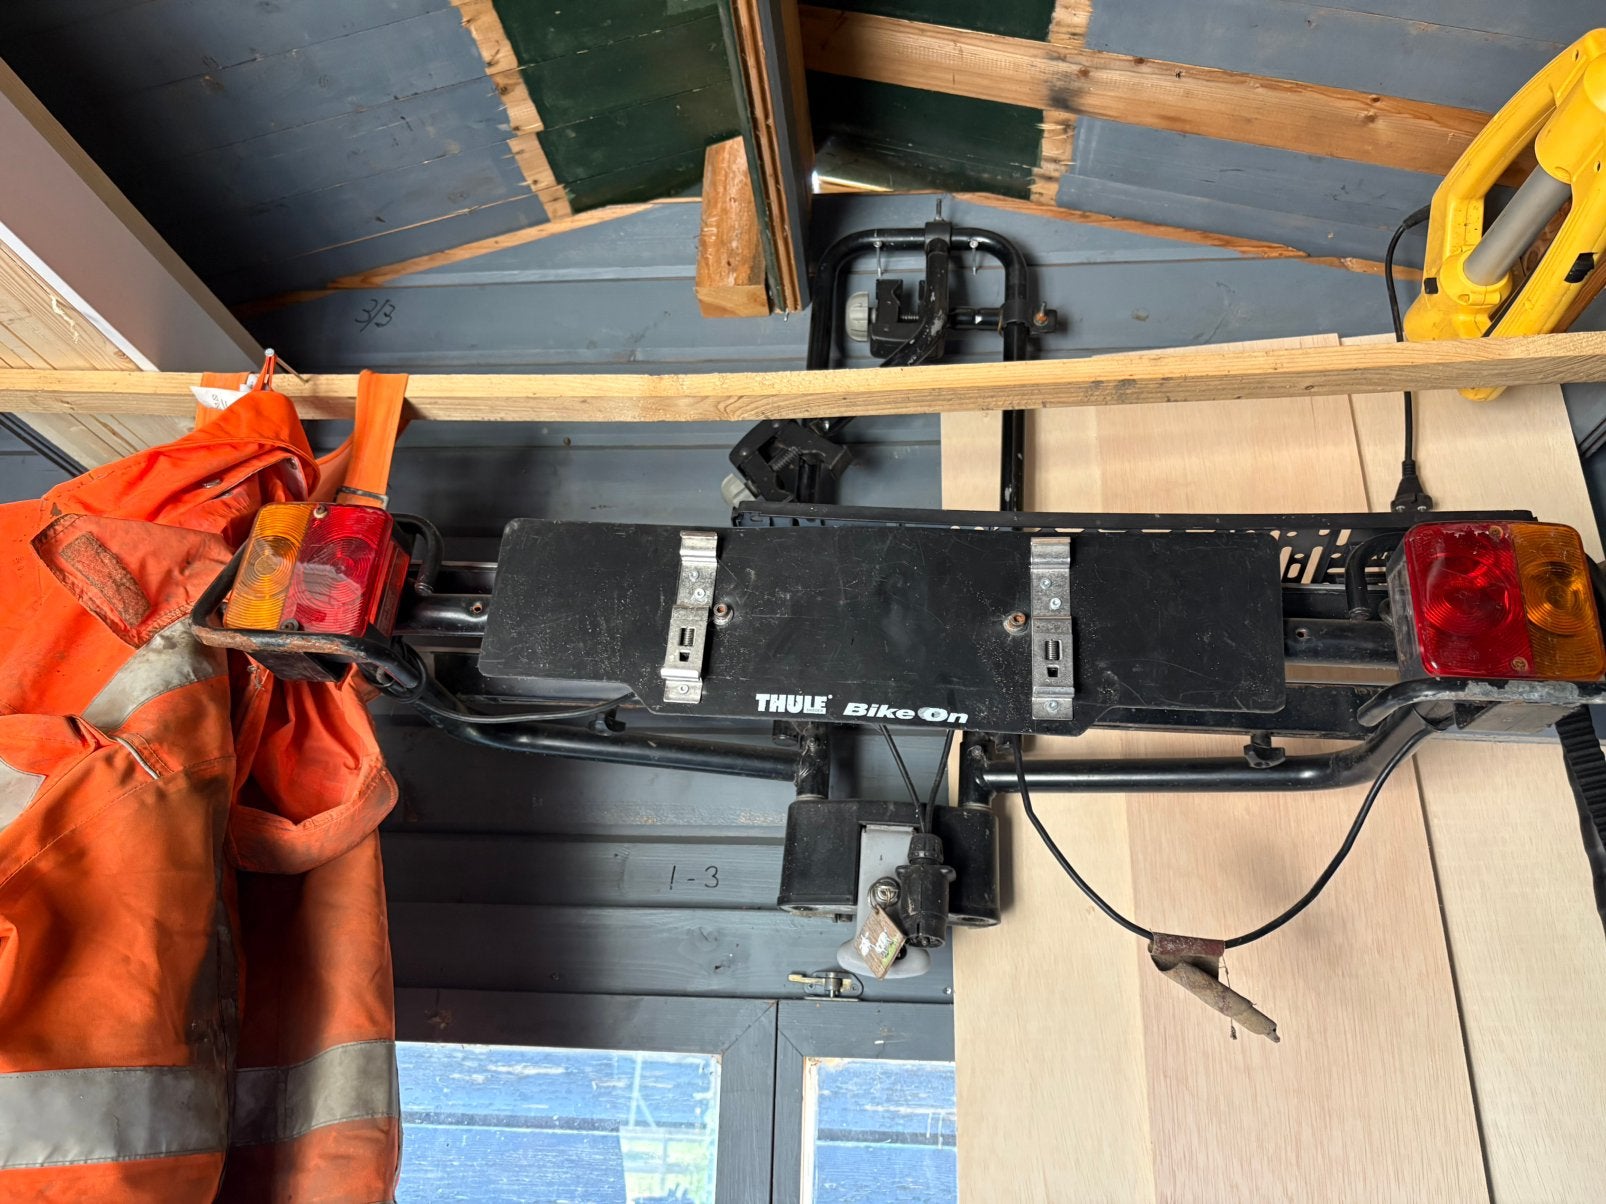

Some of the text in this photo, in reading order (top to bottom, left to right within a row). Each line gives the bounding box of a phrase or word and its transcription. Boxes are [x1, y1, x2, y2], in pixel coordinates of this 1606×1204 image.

[354, 298, 396, 332] 3/3
[755, 693, 828, 714] THULE
[842, 702, 916, 720] Bike
